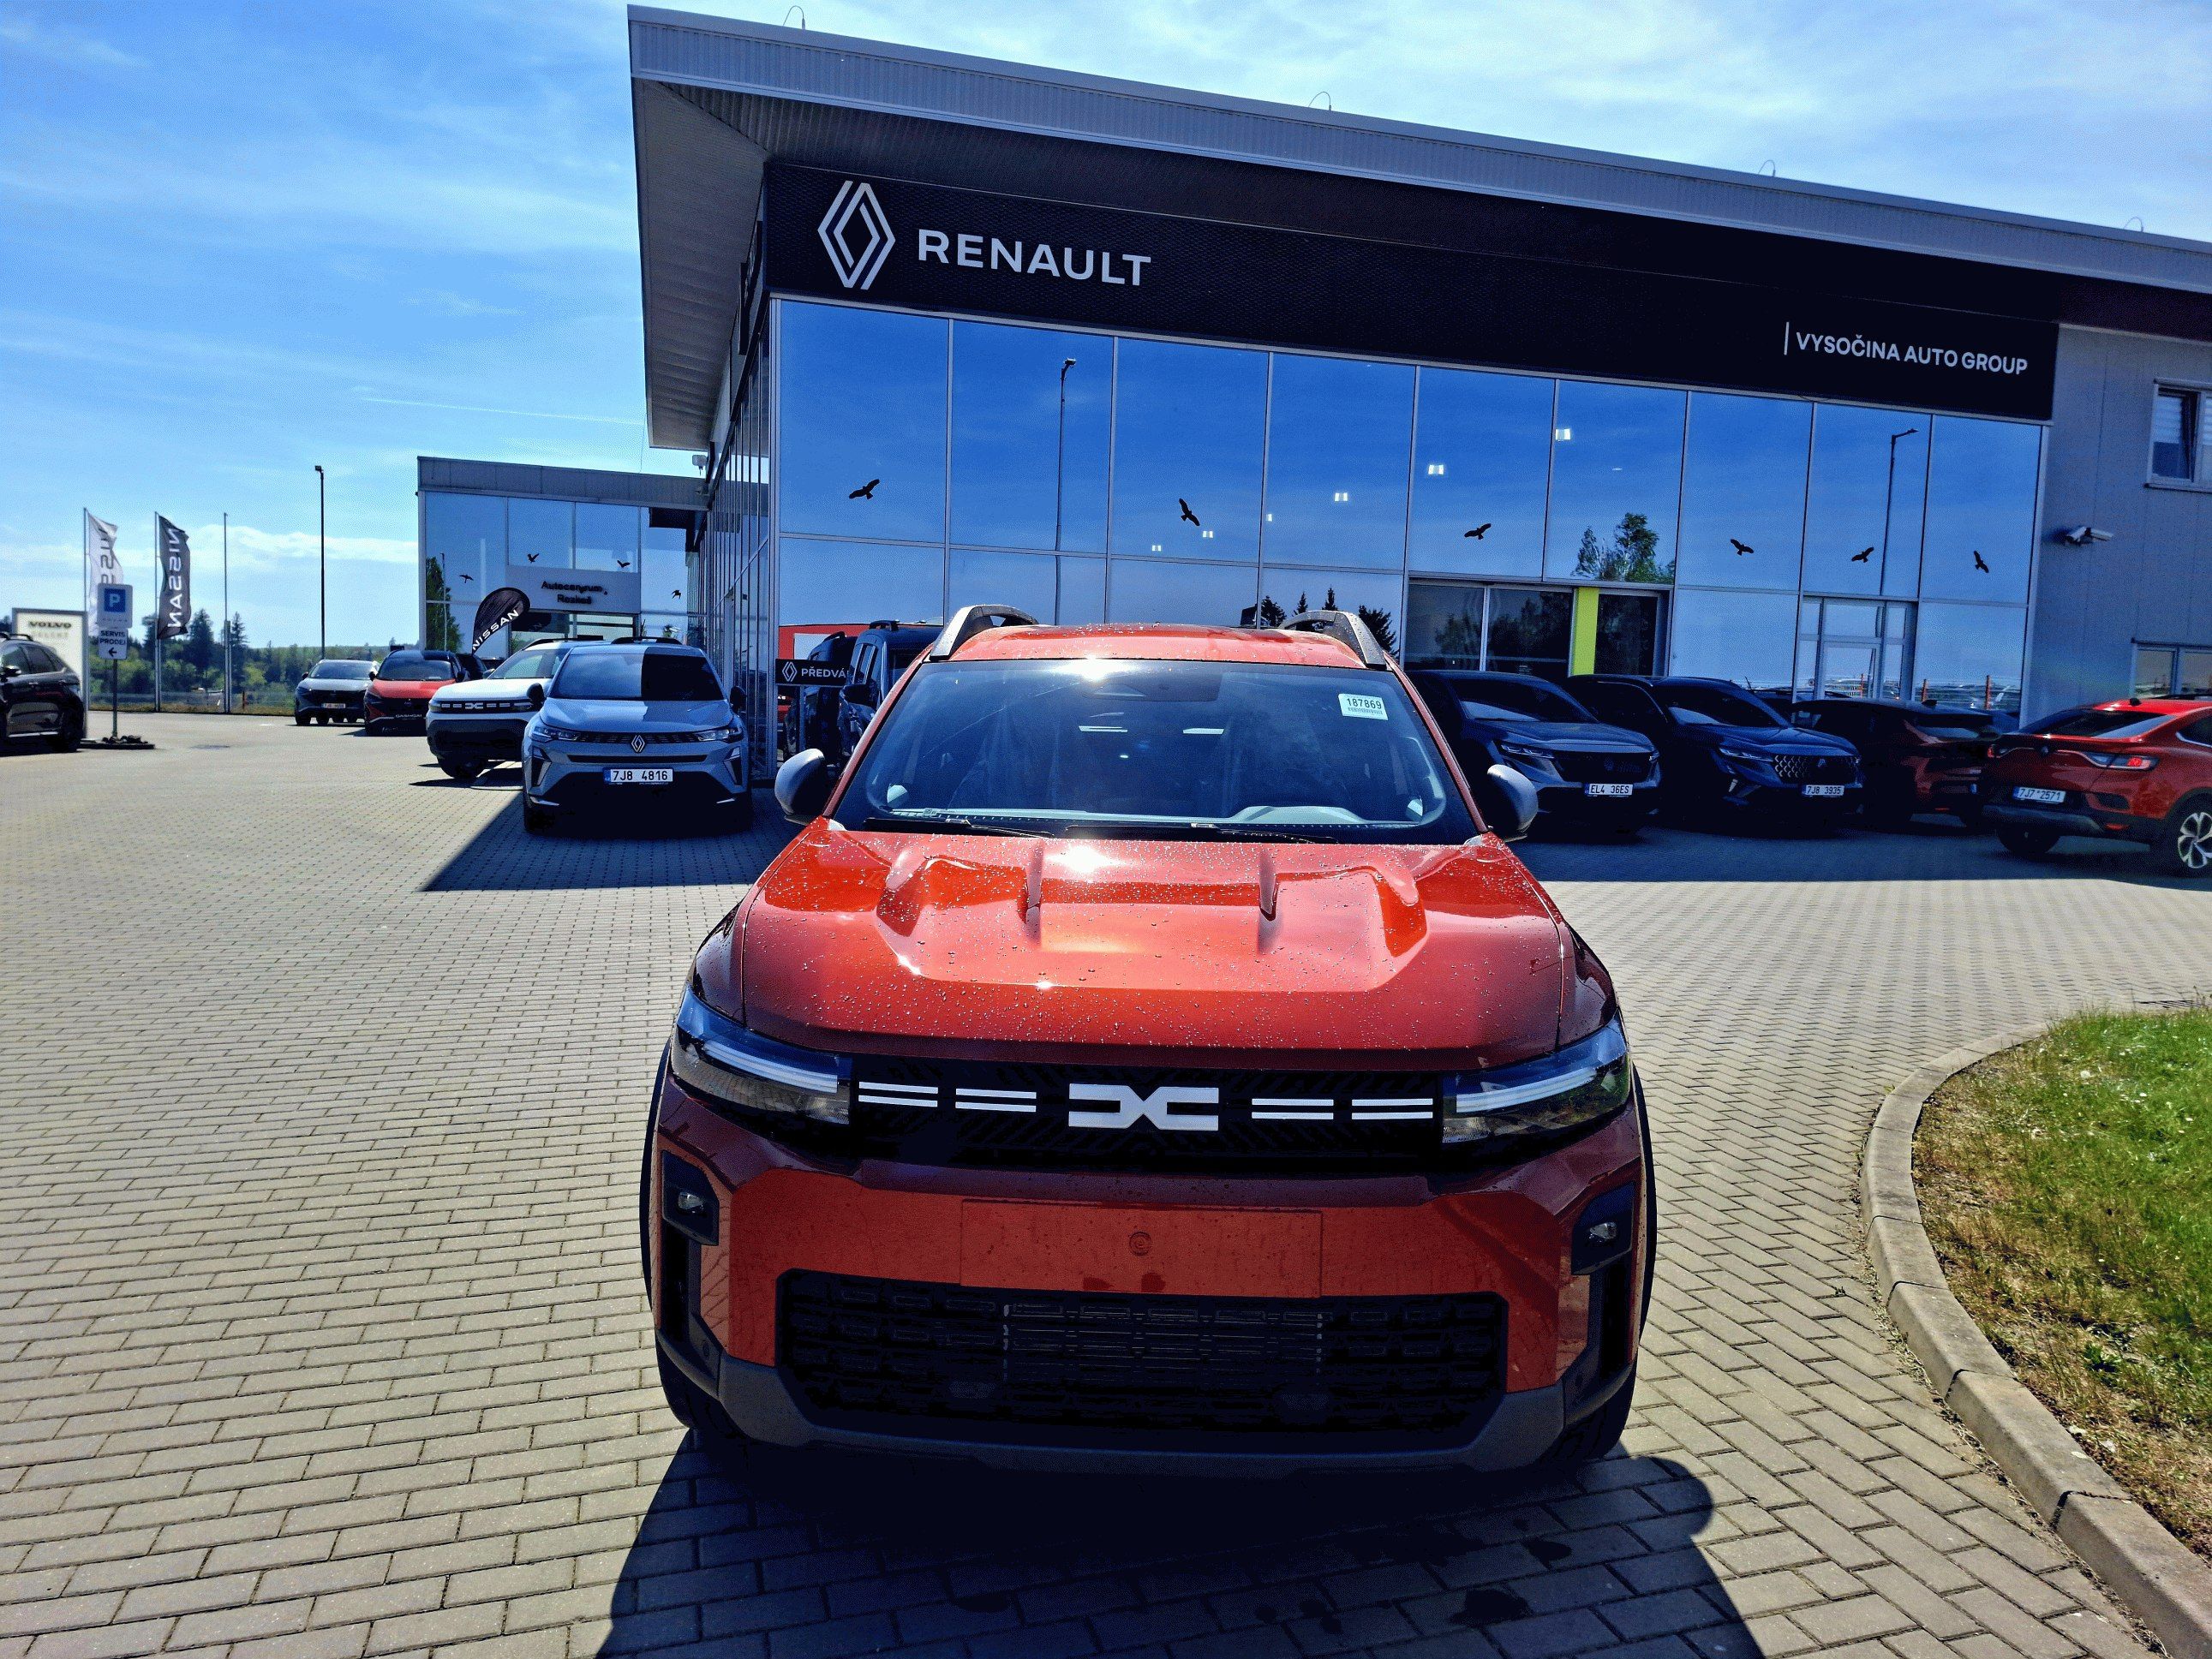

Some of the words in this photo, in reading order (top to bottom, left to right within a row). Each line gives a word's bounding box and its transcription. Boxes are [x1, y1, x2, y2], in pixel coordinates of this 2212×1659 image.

[918, 229, 1151, 287] RENAULT
[1796, 332, 1900, 361] VYSOČINA
[1904, 345, 1958, 367] AUTO
[1961, 351, 2028, 375] GROUP
[541, 581, 602, 593] Autocenrum
[109, 594, 120, 607] P
[29, 621, 72, 630] VOLVO
[472, 609, 519, 651] NISSAN
[801, 665, 850, 678] PŘEDVÁ
[1347, 698, 1382, 710] 187869
[613, 770, 633, 781] 7J8
[641, 770, 668, 781] 4816
[1591, 785, 1605, 794] EL4
[1611, 785, 1629, 794] 36ES
[2019, 788, 2036, 798] 7J7
[2040, 791, 2061, 801] 2571
